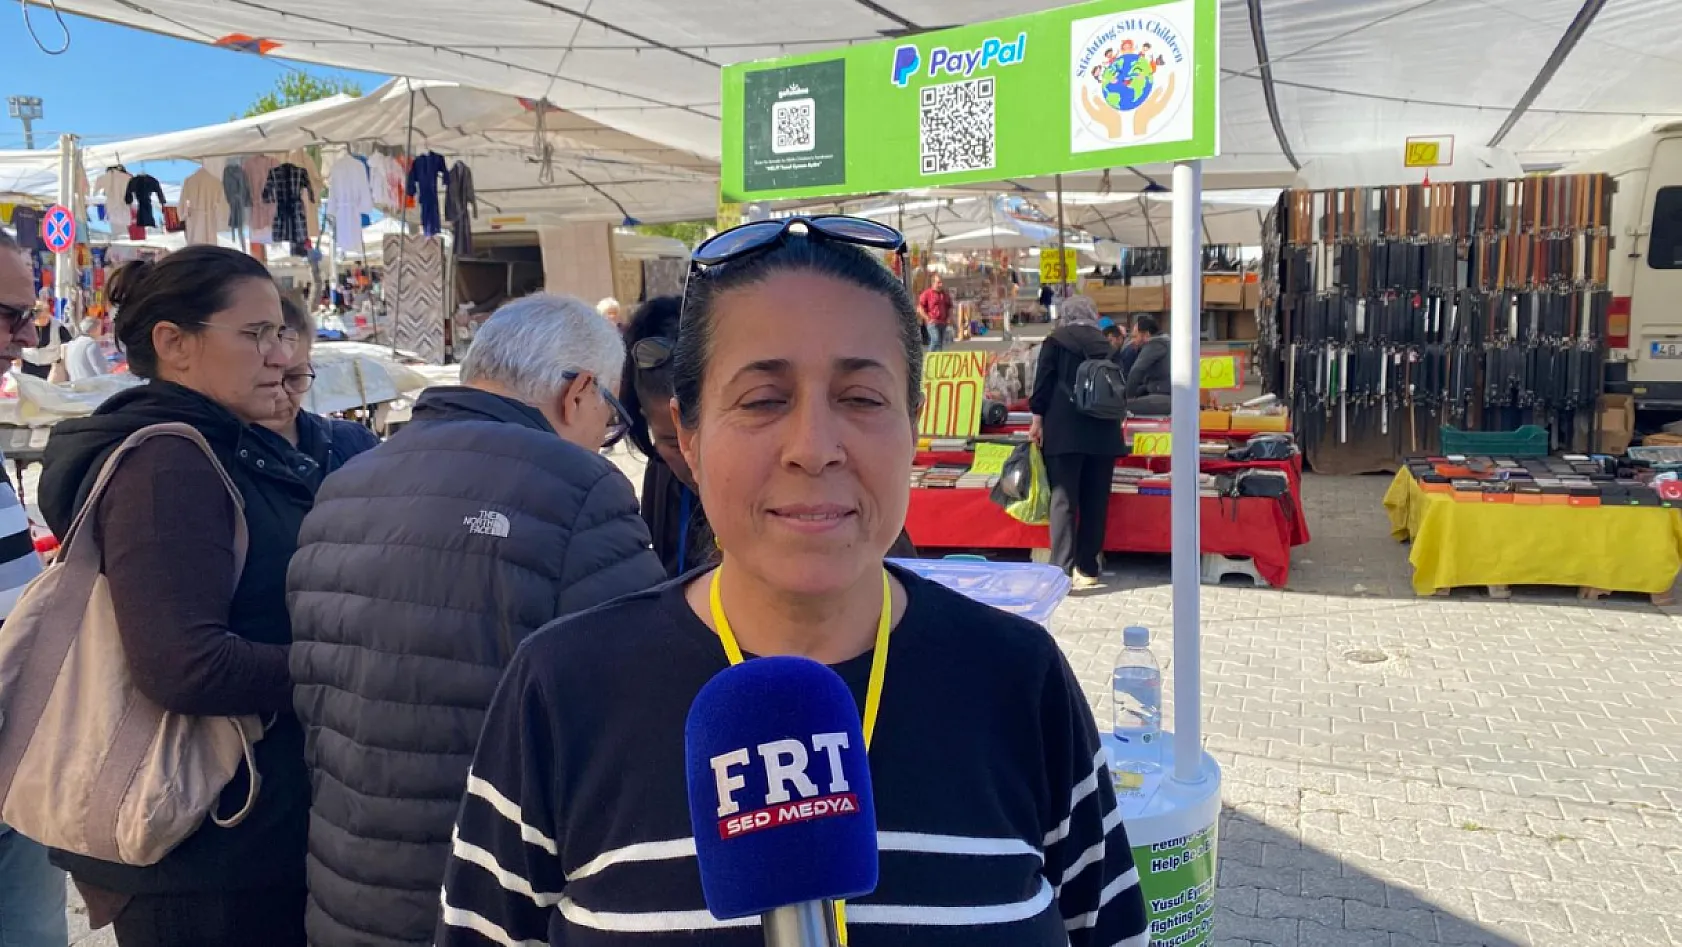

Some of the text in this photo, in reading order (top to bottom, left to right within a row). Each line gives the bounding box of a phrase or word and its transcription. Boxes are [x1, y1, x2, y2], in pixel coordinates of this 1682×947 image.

[928, 32, 1027, 76] PayPal
[1076, 26, 1117, 78] Stichting
[1145, 20, 1184, 63] Children
[926, 351, 987, 379] CUZDAN
[922, 380, 977, 437] 100
[1136, 434, 1169, 455] 100
[462, 515, 494, 527] NORTH
[479, 510, 497, 519] THE
[469, 526, 495, 535] FACE
[710, 732, 850, 818] FRT
[727, 797, 856, 835] SED MEDYA
[1151, 855, 1180, 872] Help
[1151, 890, 1185, 912] Yusuf
[1151, 909, 1193, 933] fighting
